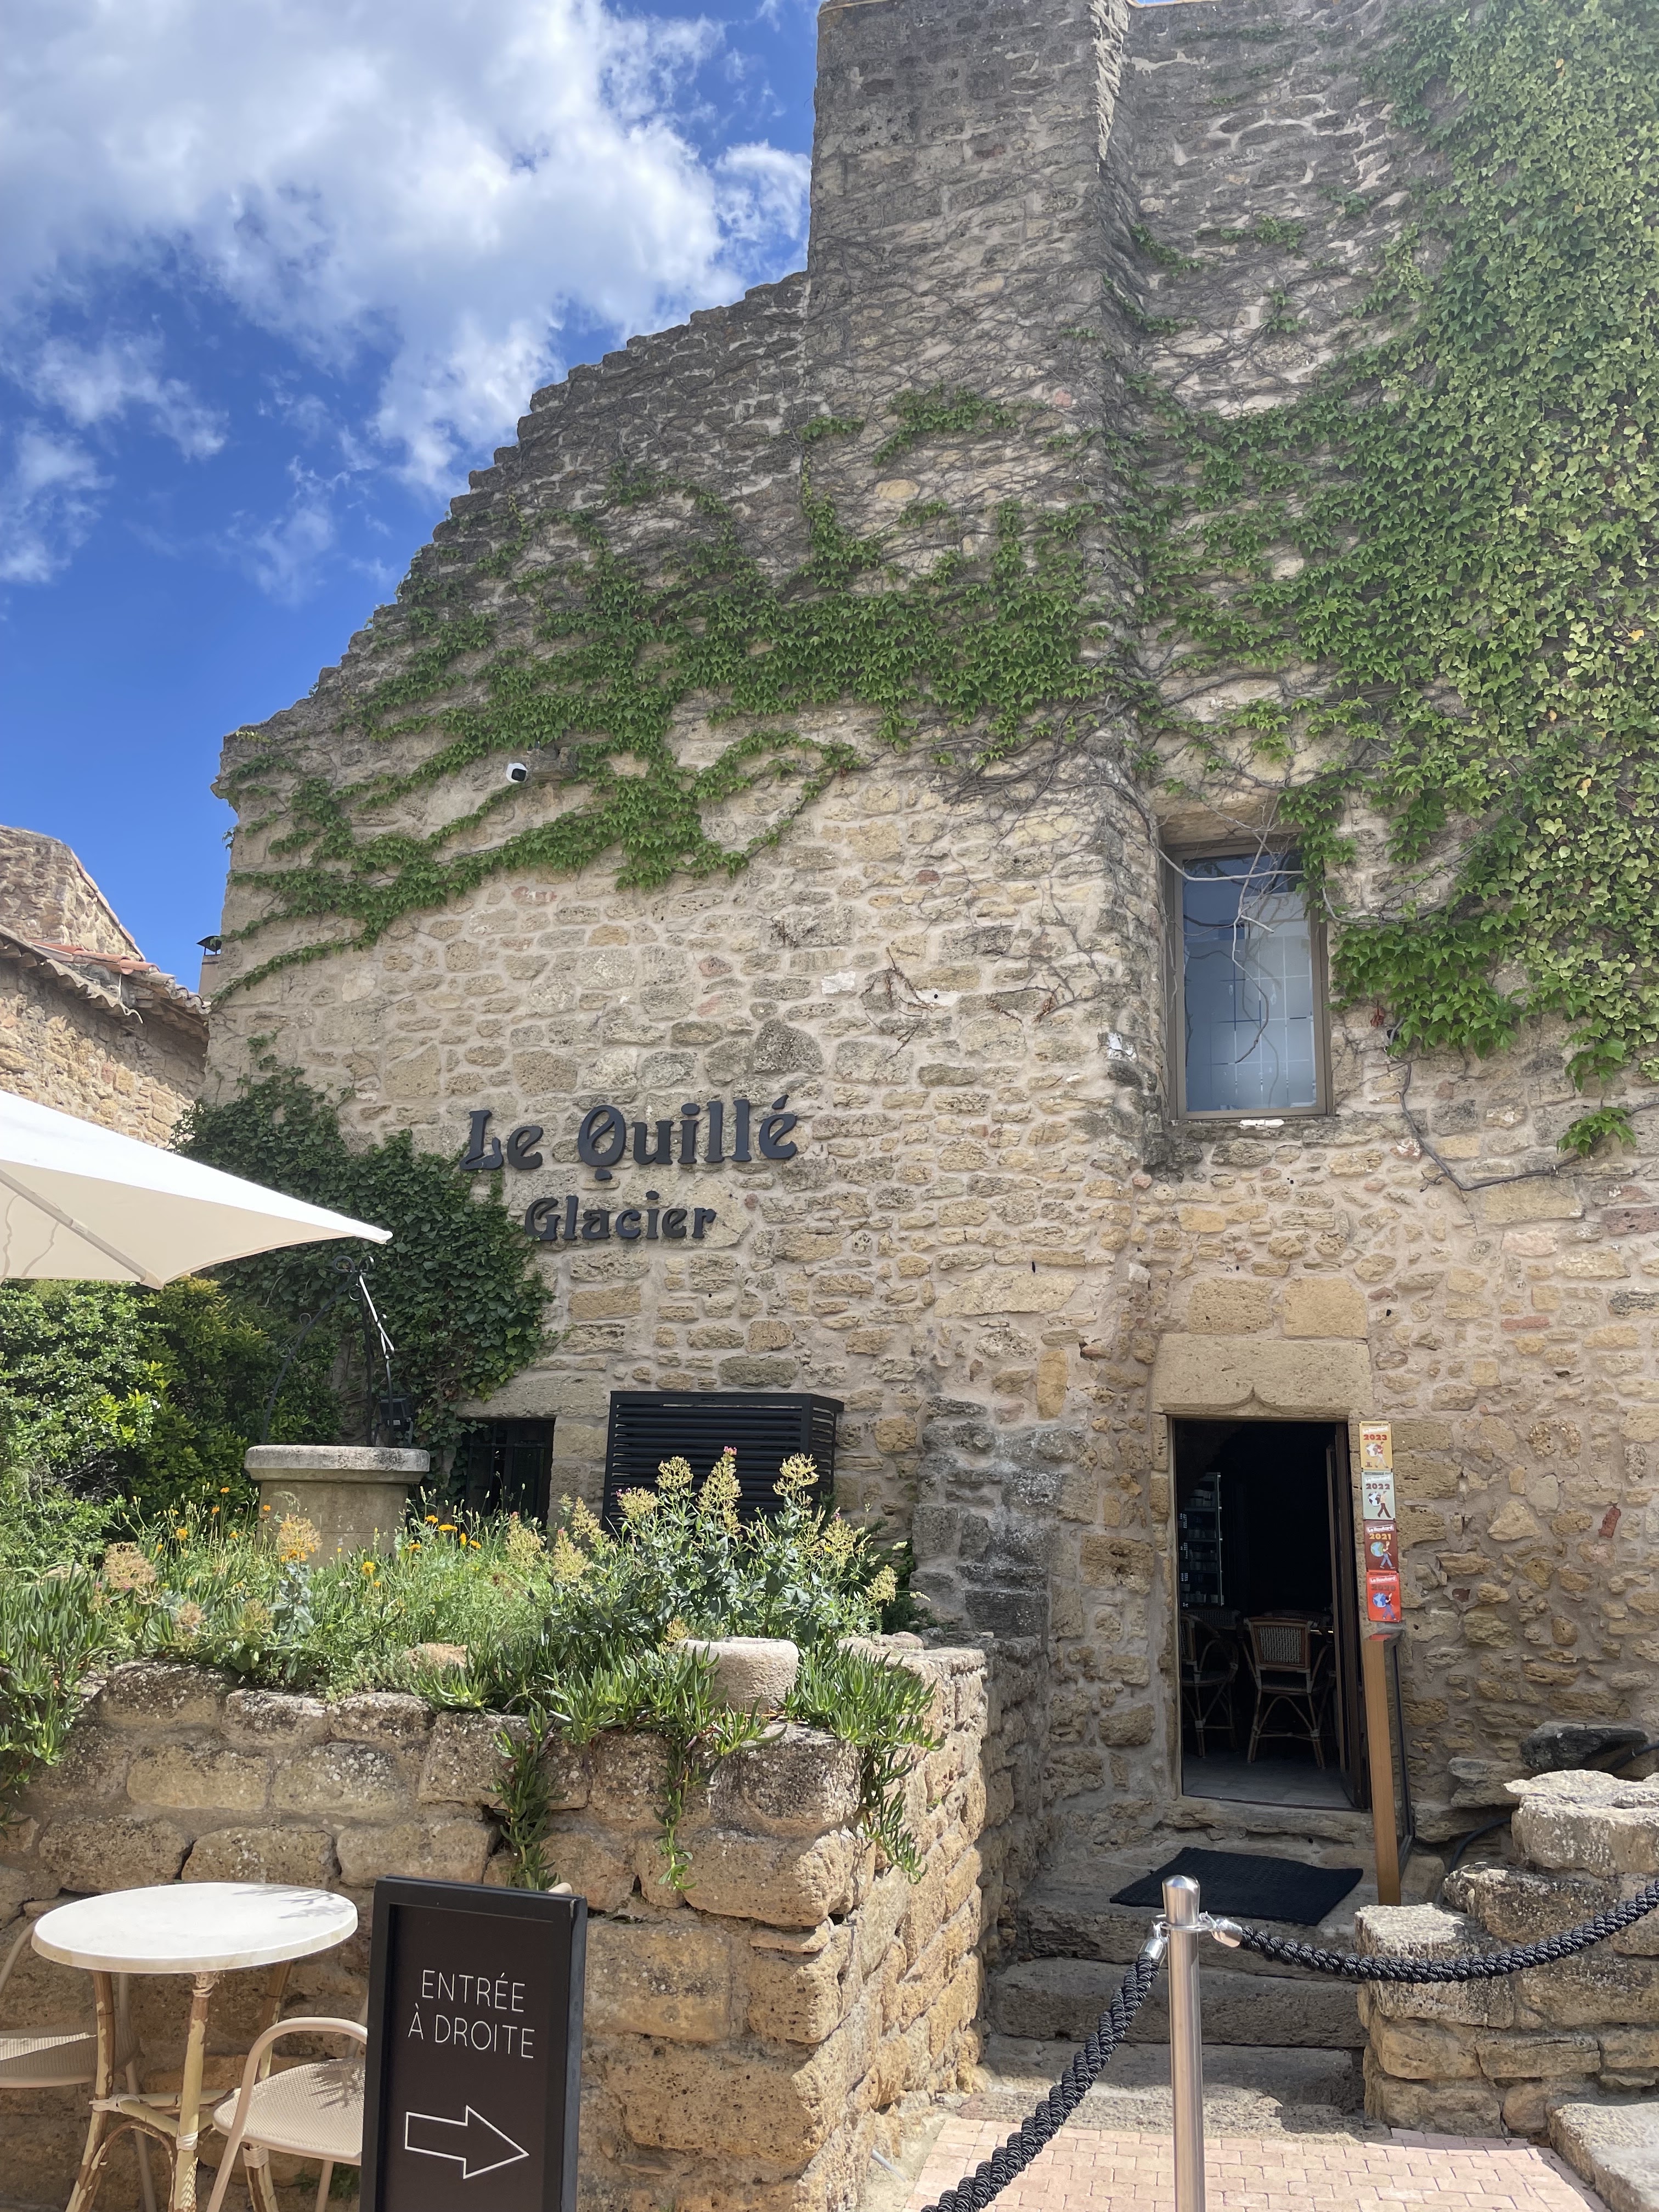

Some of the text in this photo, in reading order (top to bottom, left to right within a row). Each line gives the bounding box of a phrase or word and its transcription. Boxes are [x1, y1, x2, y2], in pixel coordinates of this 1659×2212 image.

[459, 1094, 798, 1181] Le Quillé
[524, 1190, 717, 1241] Glacier
[421, 1970, 526, 2012] ENTRÉE
[407, 2002, 535, 2058] À DROITE
